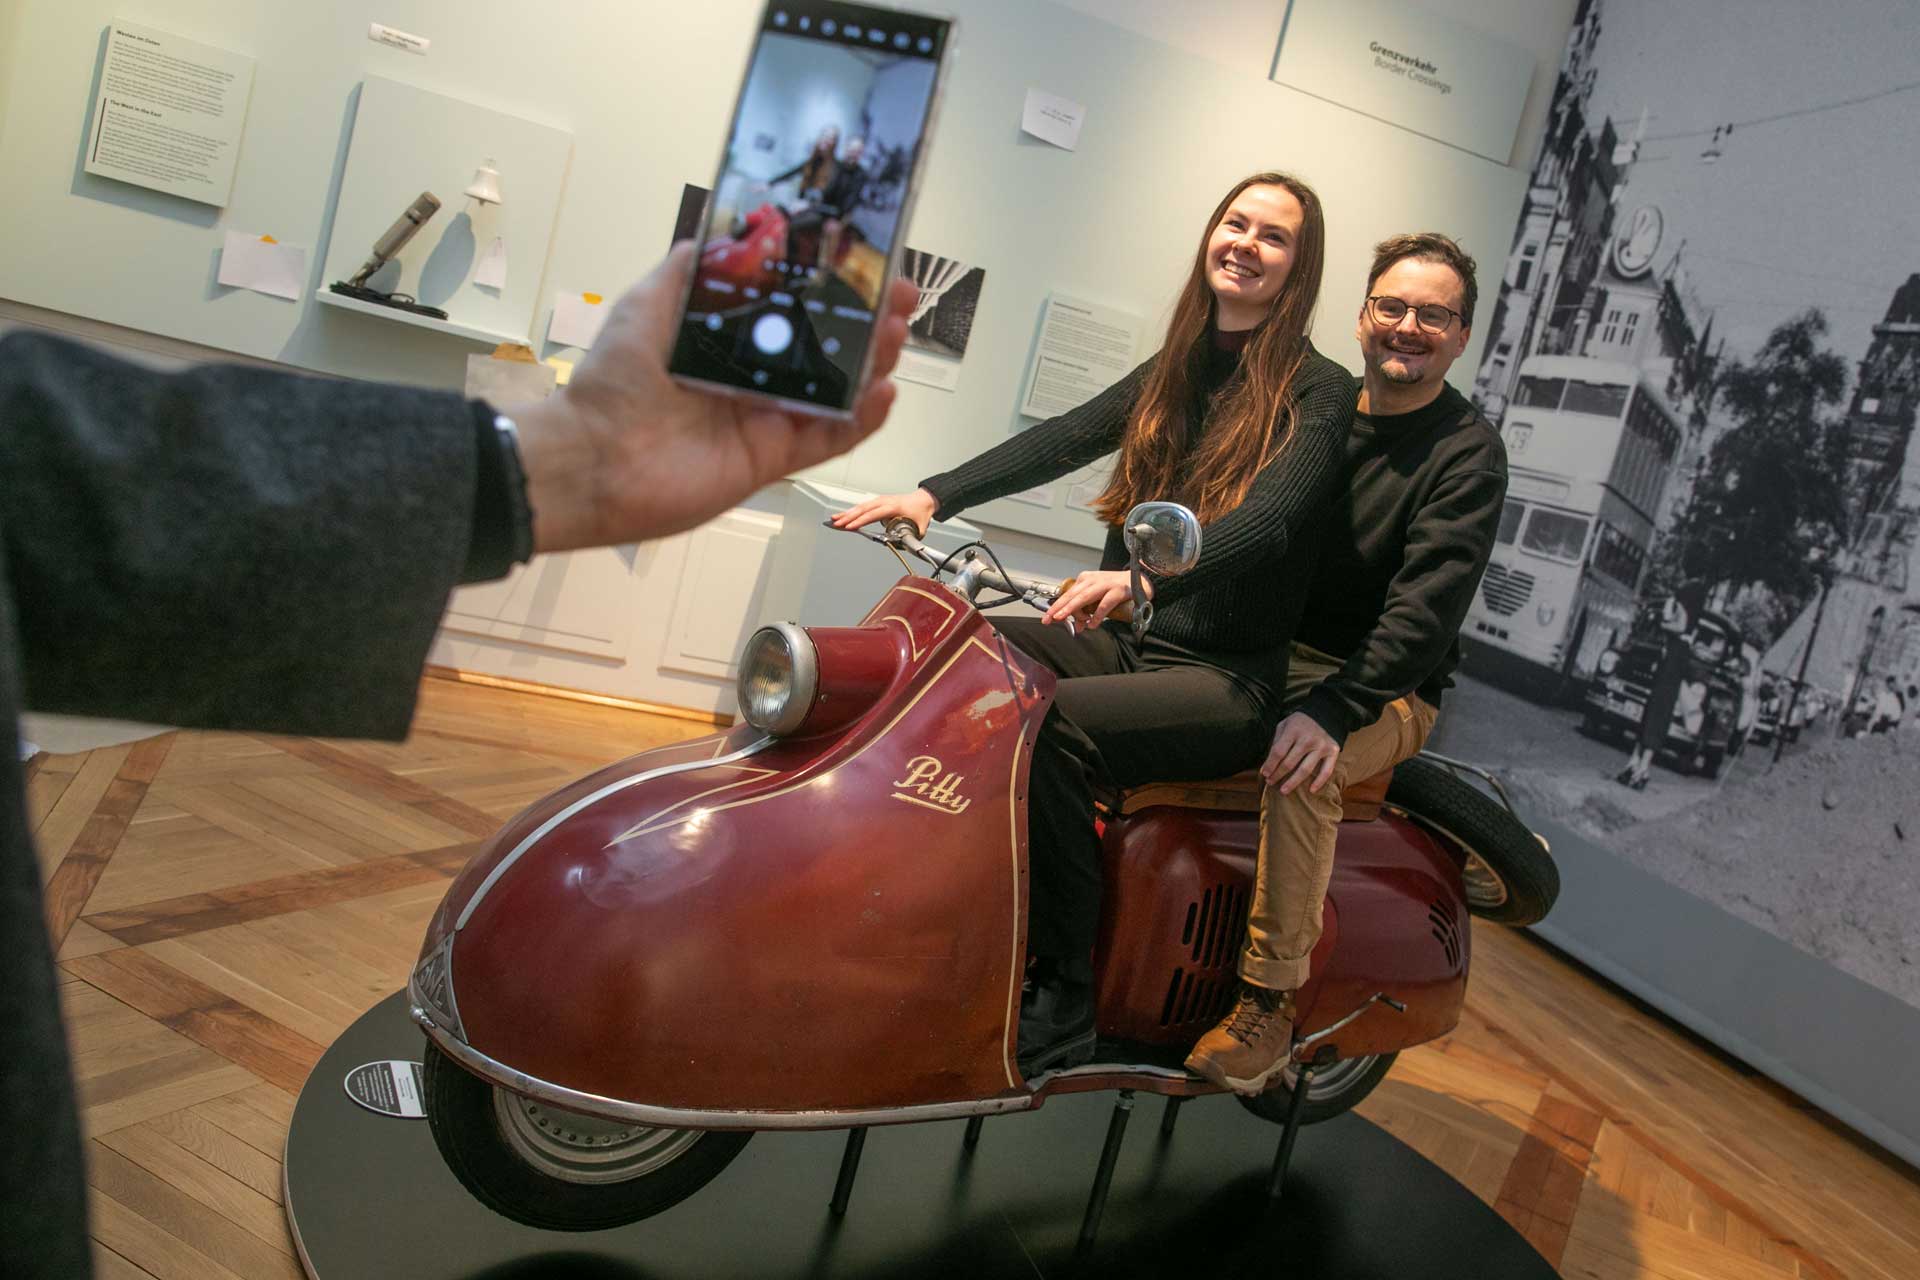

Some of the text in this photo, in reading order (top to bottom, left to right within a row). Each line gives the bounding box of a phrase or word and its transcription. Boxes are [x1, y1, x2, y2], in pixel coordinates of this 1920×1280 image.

[1369, 41, 1437, 74] Grenzverkehr
[1374, 56, 1452, 94] Border Crossings
[890, 755, 971, 815] Pitty
